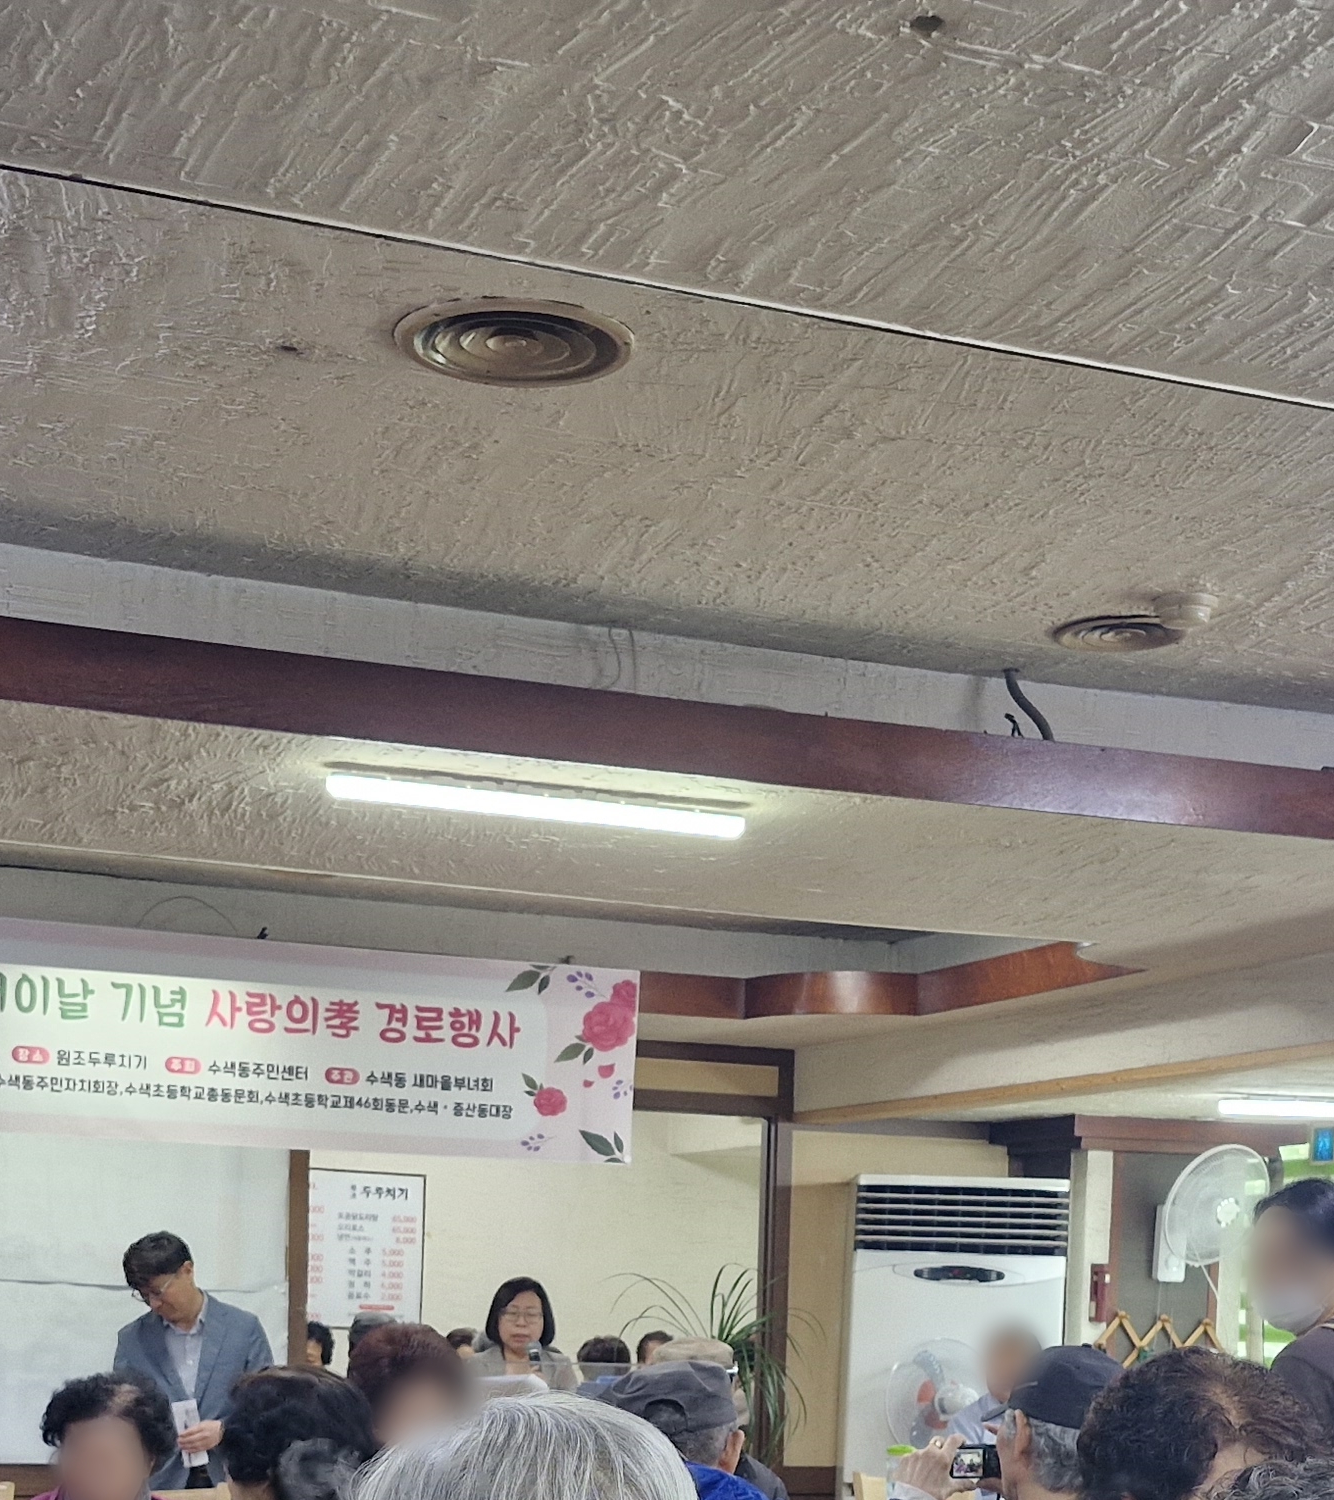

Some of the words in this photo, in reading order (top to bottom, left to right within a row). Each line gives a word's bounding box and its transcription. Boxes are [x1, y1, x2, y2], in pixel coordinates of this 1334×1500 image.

[110, 981, 188, 1029] 기념
[375, 1001, 521, 1050] 경로행사
[56, 1049, 147, 1071] 원조두루치기
[207, 1060, 309, 1081] 수색동주민센터
[365, 1070, 407, 1089] 수색동
[412, 1072, 494, 1093] 새마을부녀회
